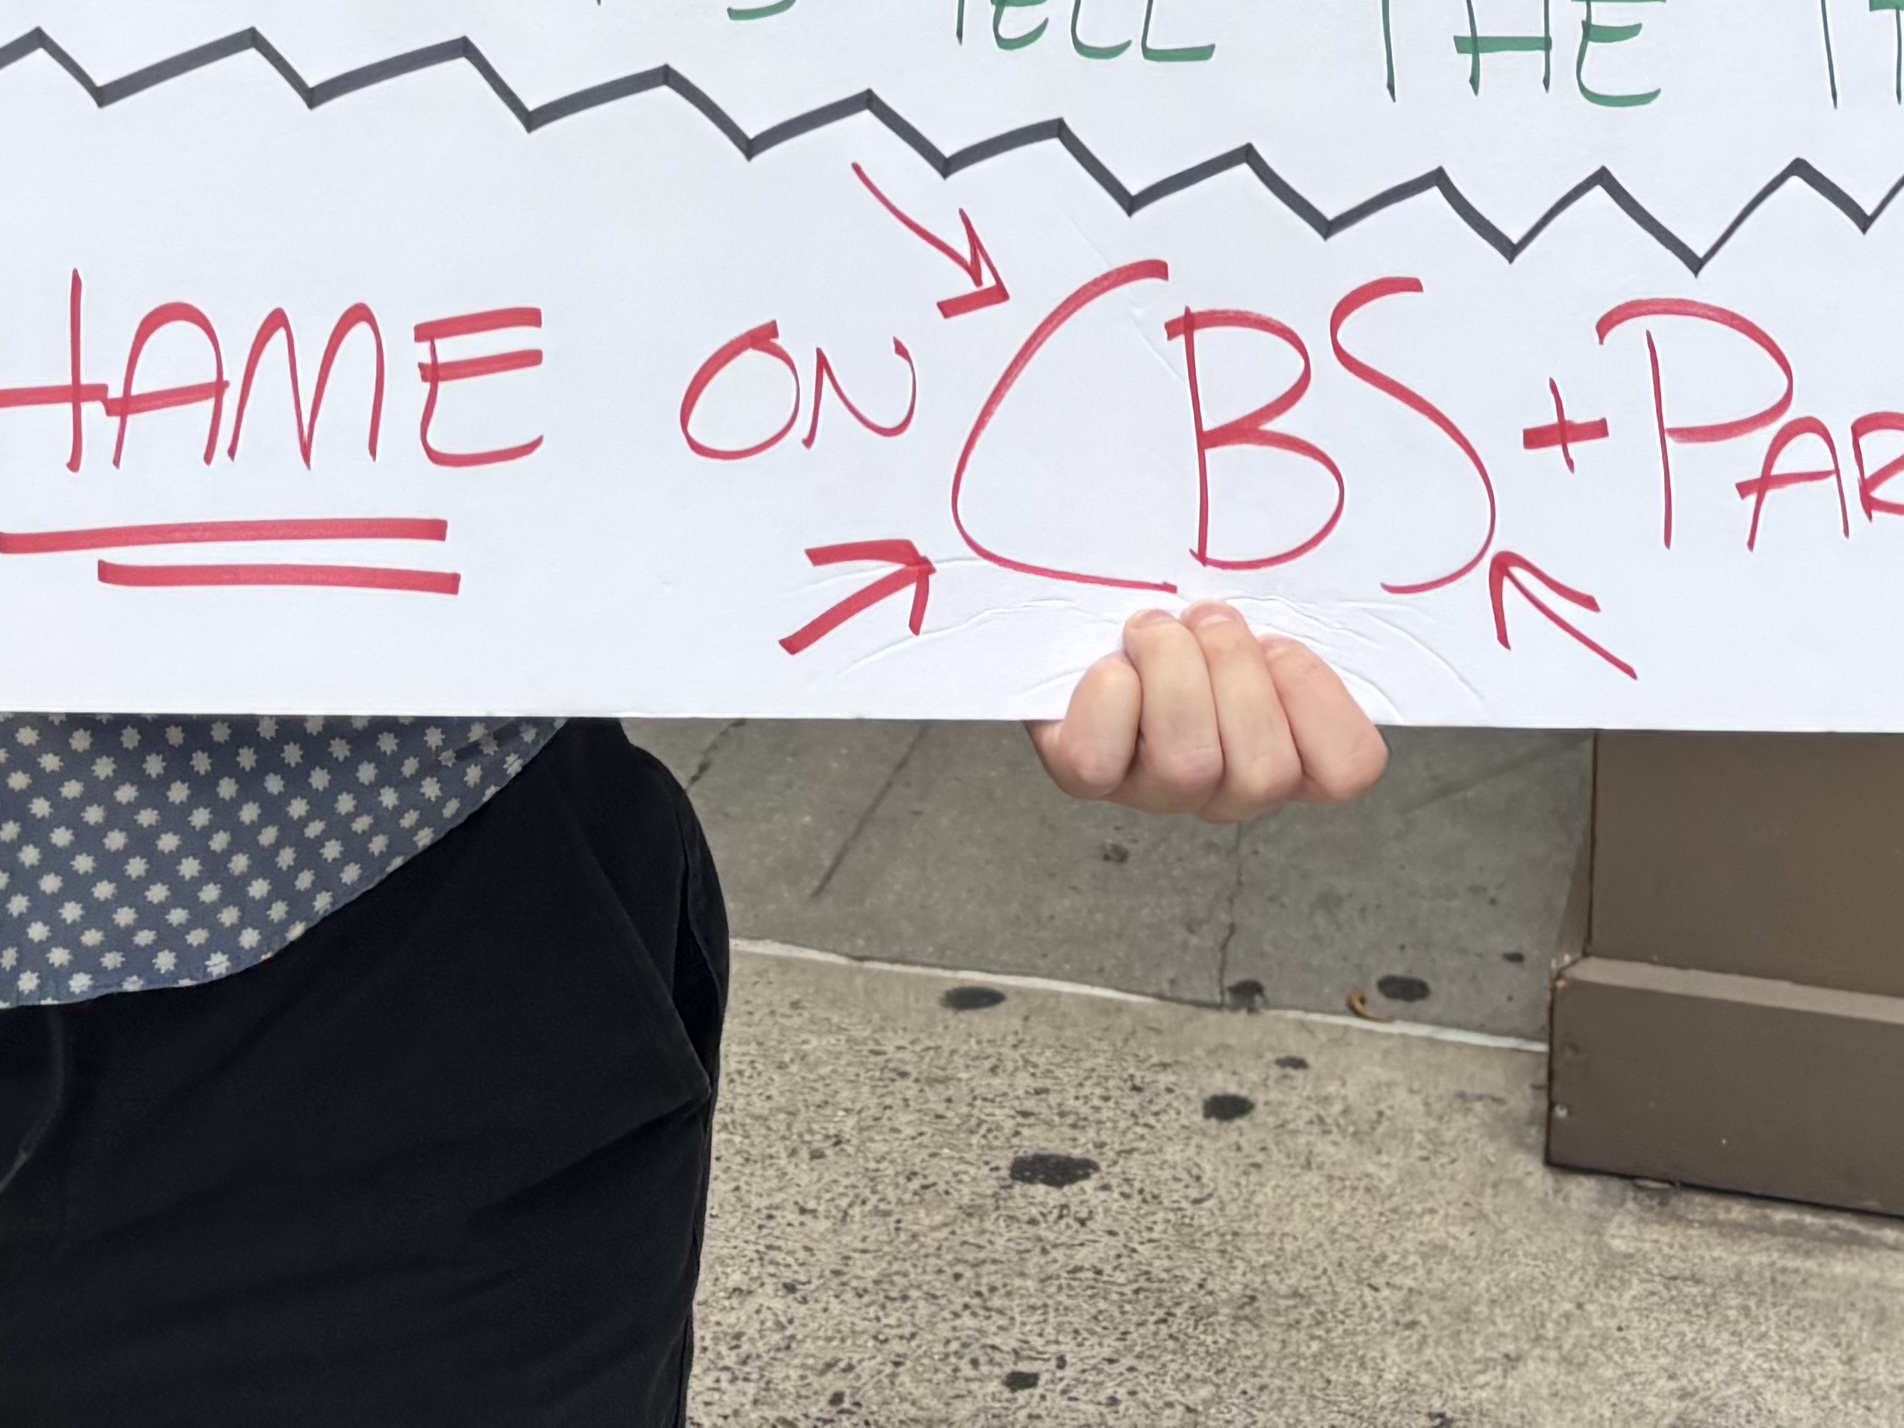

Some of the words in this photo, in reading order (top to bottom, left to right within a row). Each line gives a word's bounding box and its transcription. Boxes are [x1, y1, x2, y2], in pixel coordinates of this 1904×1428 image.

[679, 318, 919, 462] ON
[951, 259, 1495, 594] CBS
[1522, 377, 1610, 474] +
